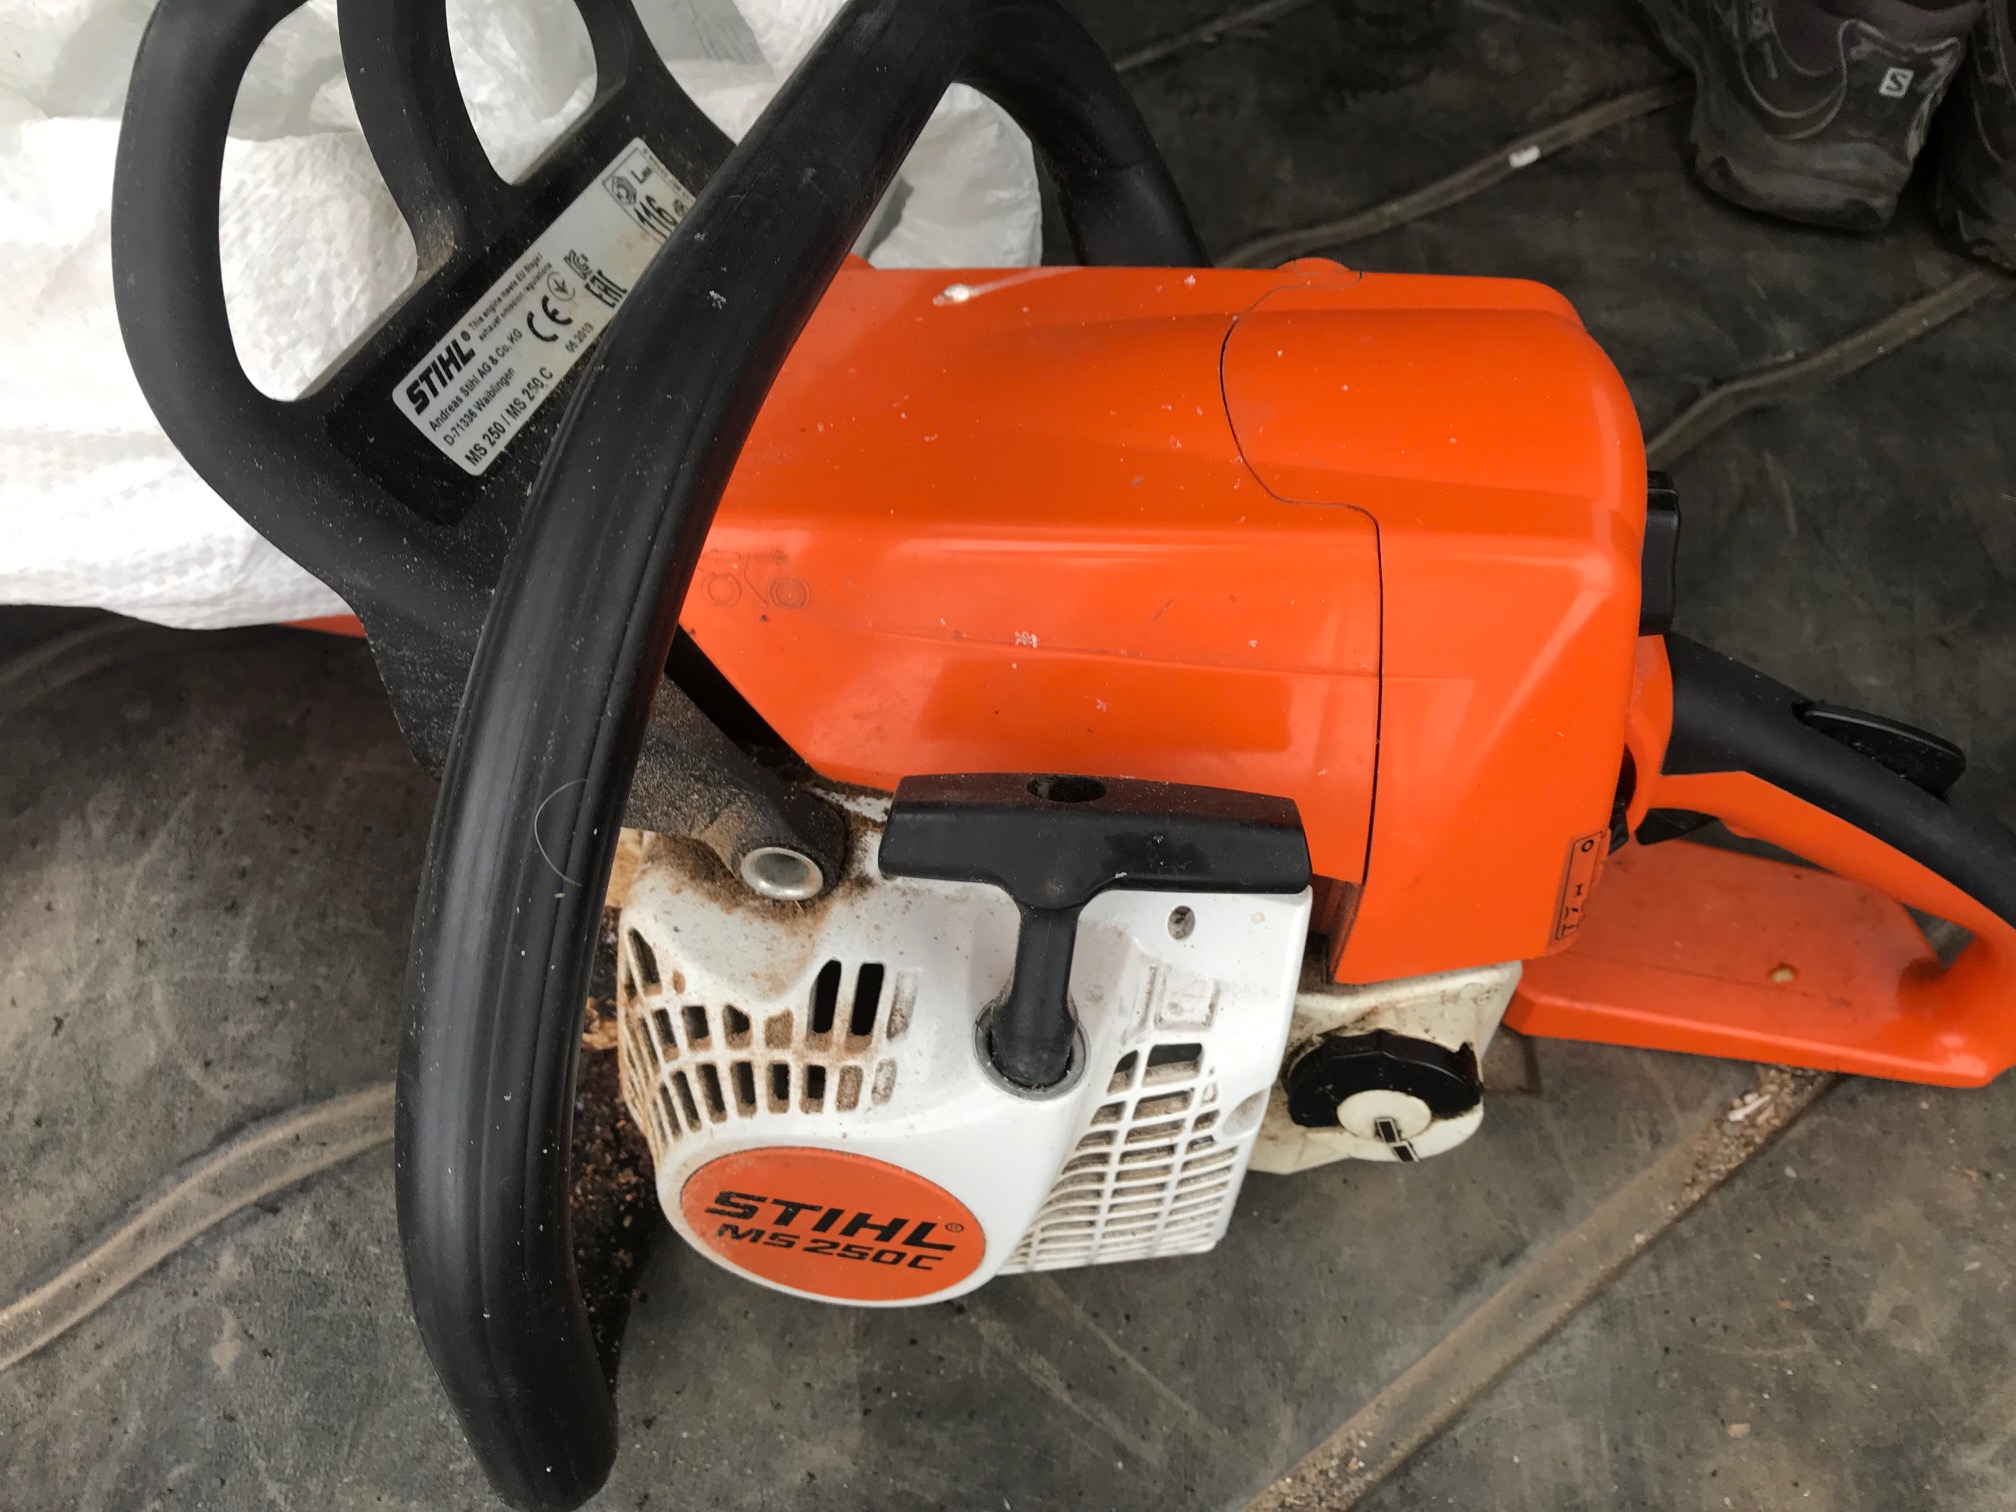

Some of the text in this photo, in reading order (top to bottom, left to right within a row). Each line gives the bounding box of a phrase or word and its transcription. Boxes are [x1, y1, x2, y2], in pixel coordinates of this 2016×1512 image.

[634, 194, 678, 239] 116
[429, 328, 523, 431] Andreas Stihl AG & Co. KG
[444, 368, 515, 446] D-71336 Waiblingen
[465, 367, 553, 466] MS 250 / MS 250 C
[717, 1223, 800, 1250] MS
